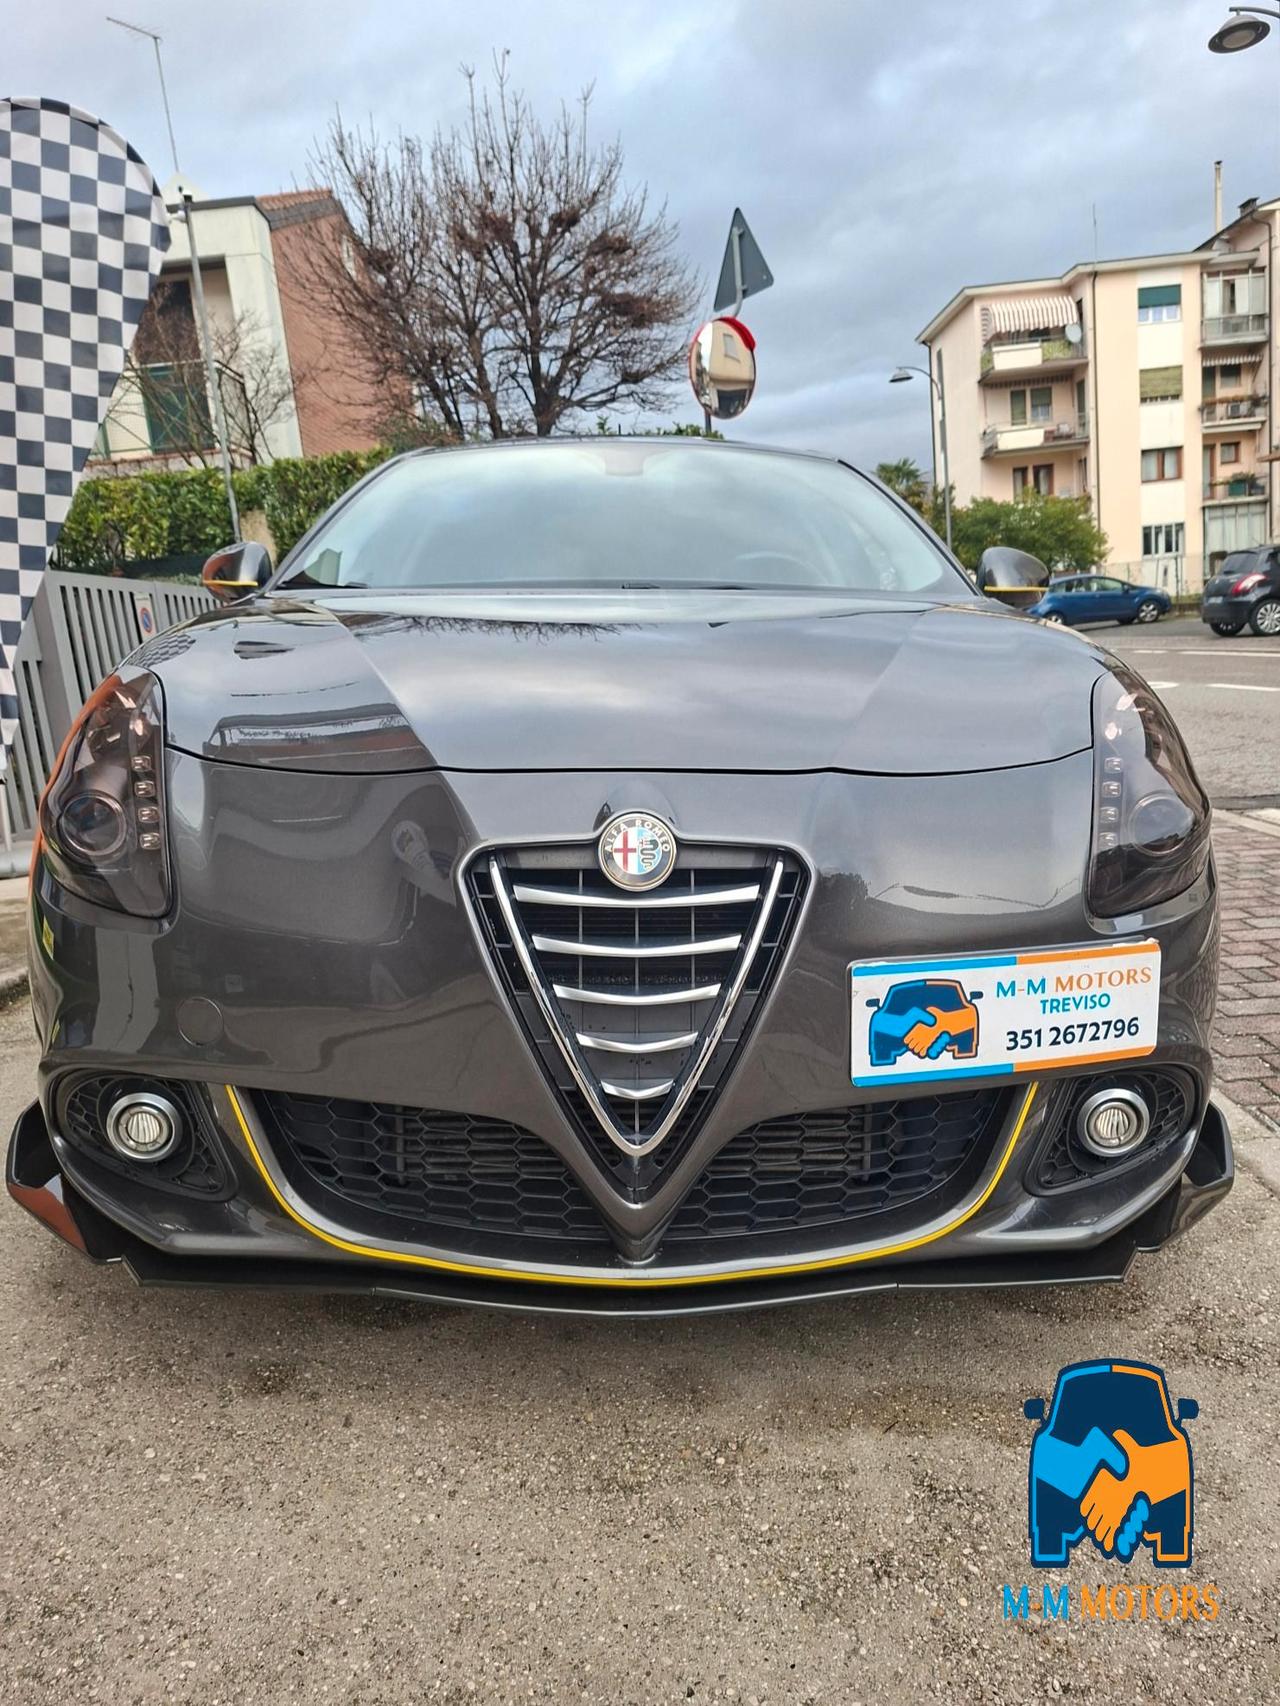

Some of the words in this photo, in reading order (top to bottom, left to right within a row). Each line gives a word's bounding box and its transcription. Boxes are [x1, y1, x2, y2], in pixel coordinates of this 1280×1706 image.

[604, 822, 628, 853] ALFA
[635, 819, 671, 852] ROMEO
[996, 976, 1046, 998] M-M
[1055, 966, 1152, 993] MOTORS
[1040, 993, 1111, 1014] TREVISO
[1006, 1028, 1042, 1051] 351
[1048, 1016, 1140, 1047] 2672796
